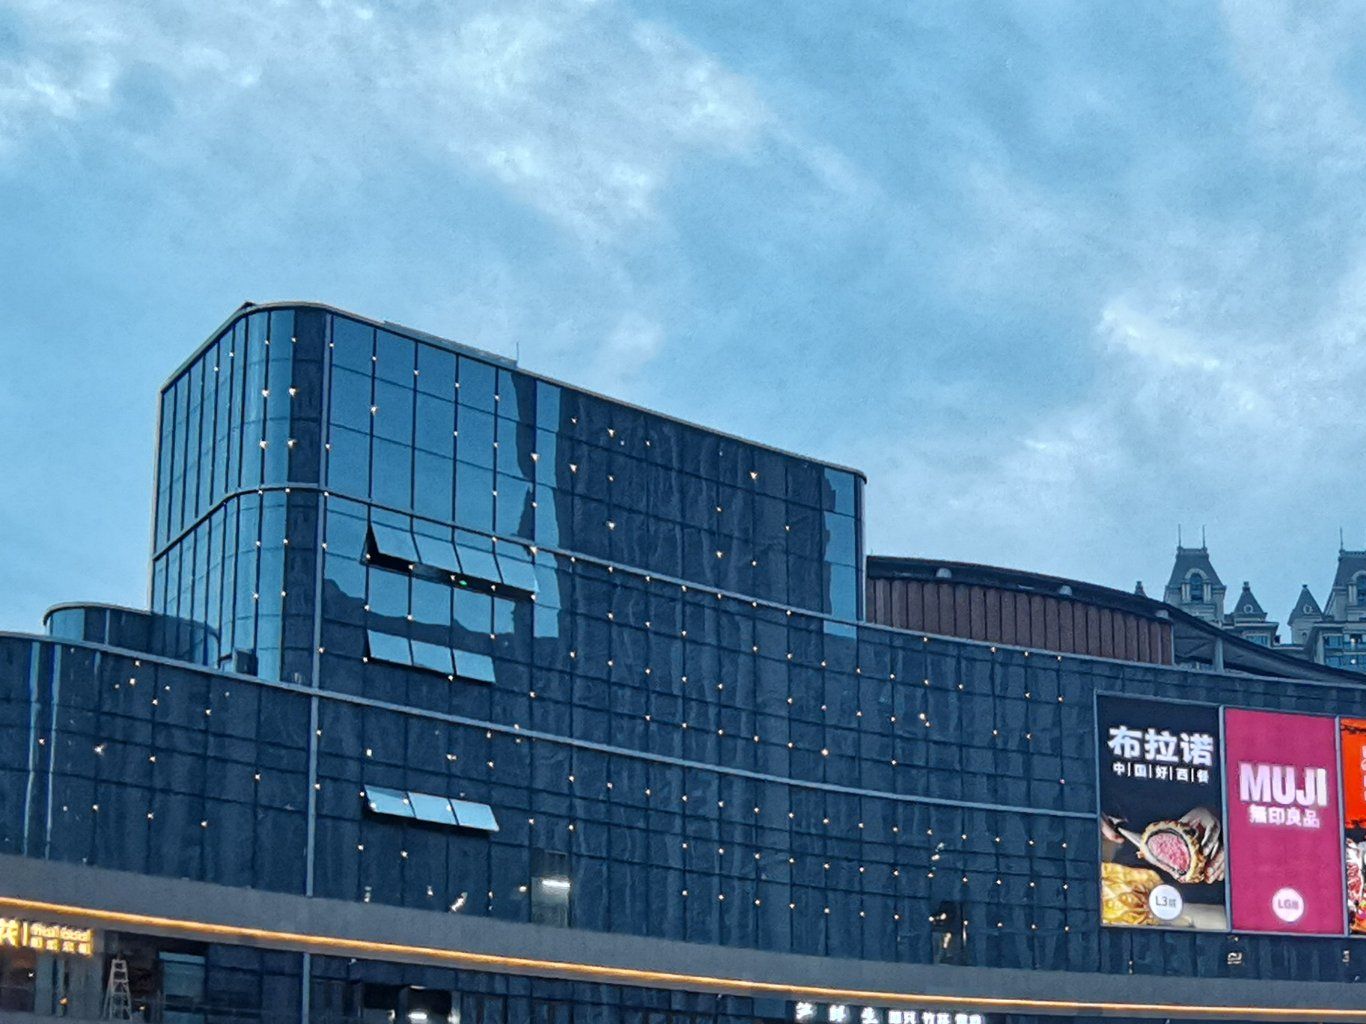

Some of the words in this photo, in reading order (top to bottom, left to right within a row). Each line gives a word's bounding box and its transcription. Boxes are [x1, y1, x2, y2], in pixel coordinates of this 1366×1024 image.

[1107, 725, 1214, 767] 布拉诺
[1239, 762, 1327, 807] MUJI
